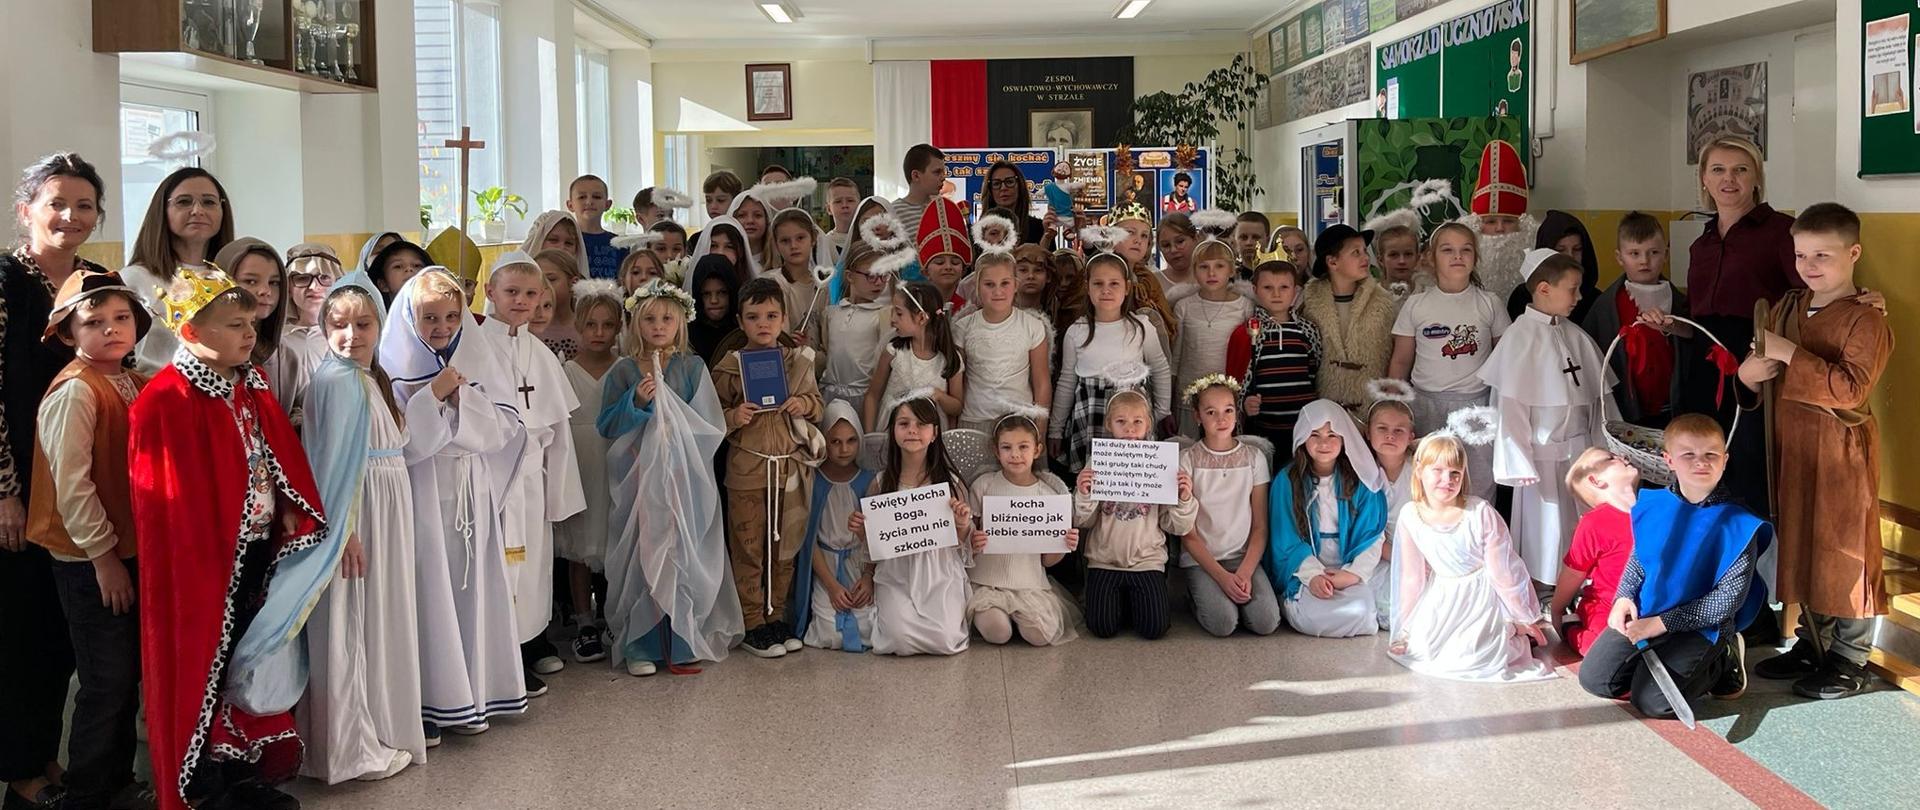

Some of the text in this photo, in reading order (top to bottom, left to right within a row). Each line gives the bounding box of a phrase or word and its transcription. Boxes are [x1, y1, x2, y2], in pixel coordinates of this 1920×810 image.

[1074, 156, 1103, 167] ŻYCIE
[1114, 451, 1143, 459] świętym
[1114, 470, 1142, 478] świętym
[870, 489, 945, 510] Święty kocha
[1010, 500, 1045, 508] kocha
[894, 509, 927, 521] Boga,
[992, 513, 1064, 524] bliźniego jak
[880, 519, 949, 541] życia mu nie
[986, 528, 1066, 538] siebie samego
[894, 538, 937, 553] szkoda,
